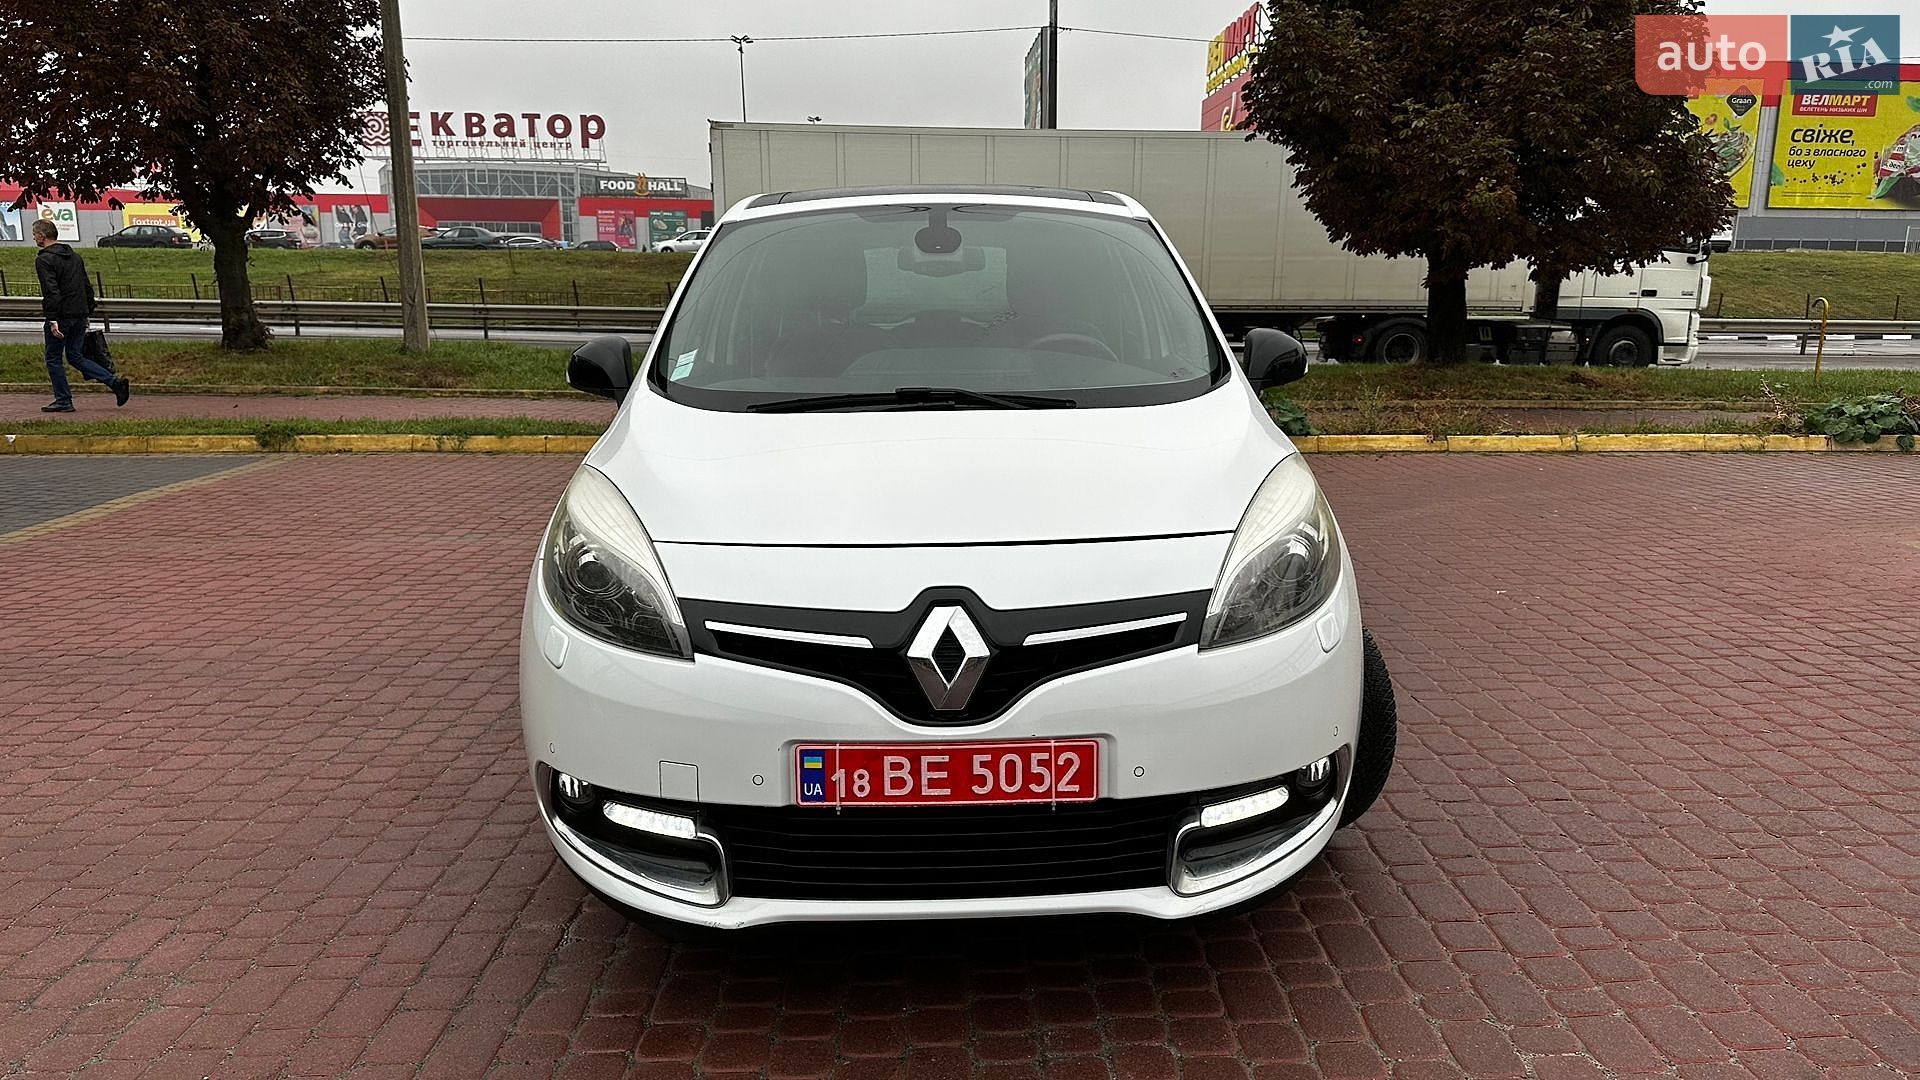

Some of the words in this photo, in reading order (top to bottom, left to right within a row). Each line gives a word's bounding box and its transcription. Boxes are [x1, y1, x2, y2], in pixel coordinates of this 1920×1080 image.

[1801, 94, 1871, 106] ВЕЛМАРТ
[1790, 123, 1855, 146] свіже,
[431, 138, 527, 150] торговельний
[533, 140, 573, 150] центр
[1788, 146, 1803, 157] бо
[1804, 148, 1811, 157] з
[1813, 148, 1866, 157] власного
[1787, 159, 1816, 170] цеху
[599, 179, 636, 191] FOOD
[647, 180, 682, 192] HALL
[831, 768, 871, 798] 18
[883, 755, 951, 796] BE
[971, 751, 1081, 795] 5052
[803, 783, 823, 796] UA
